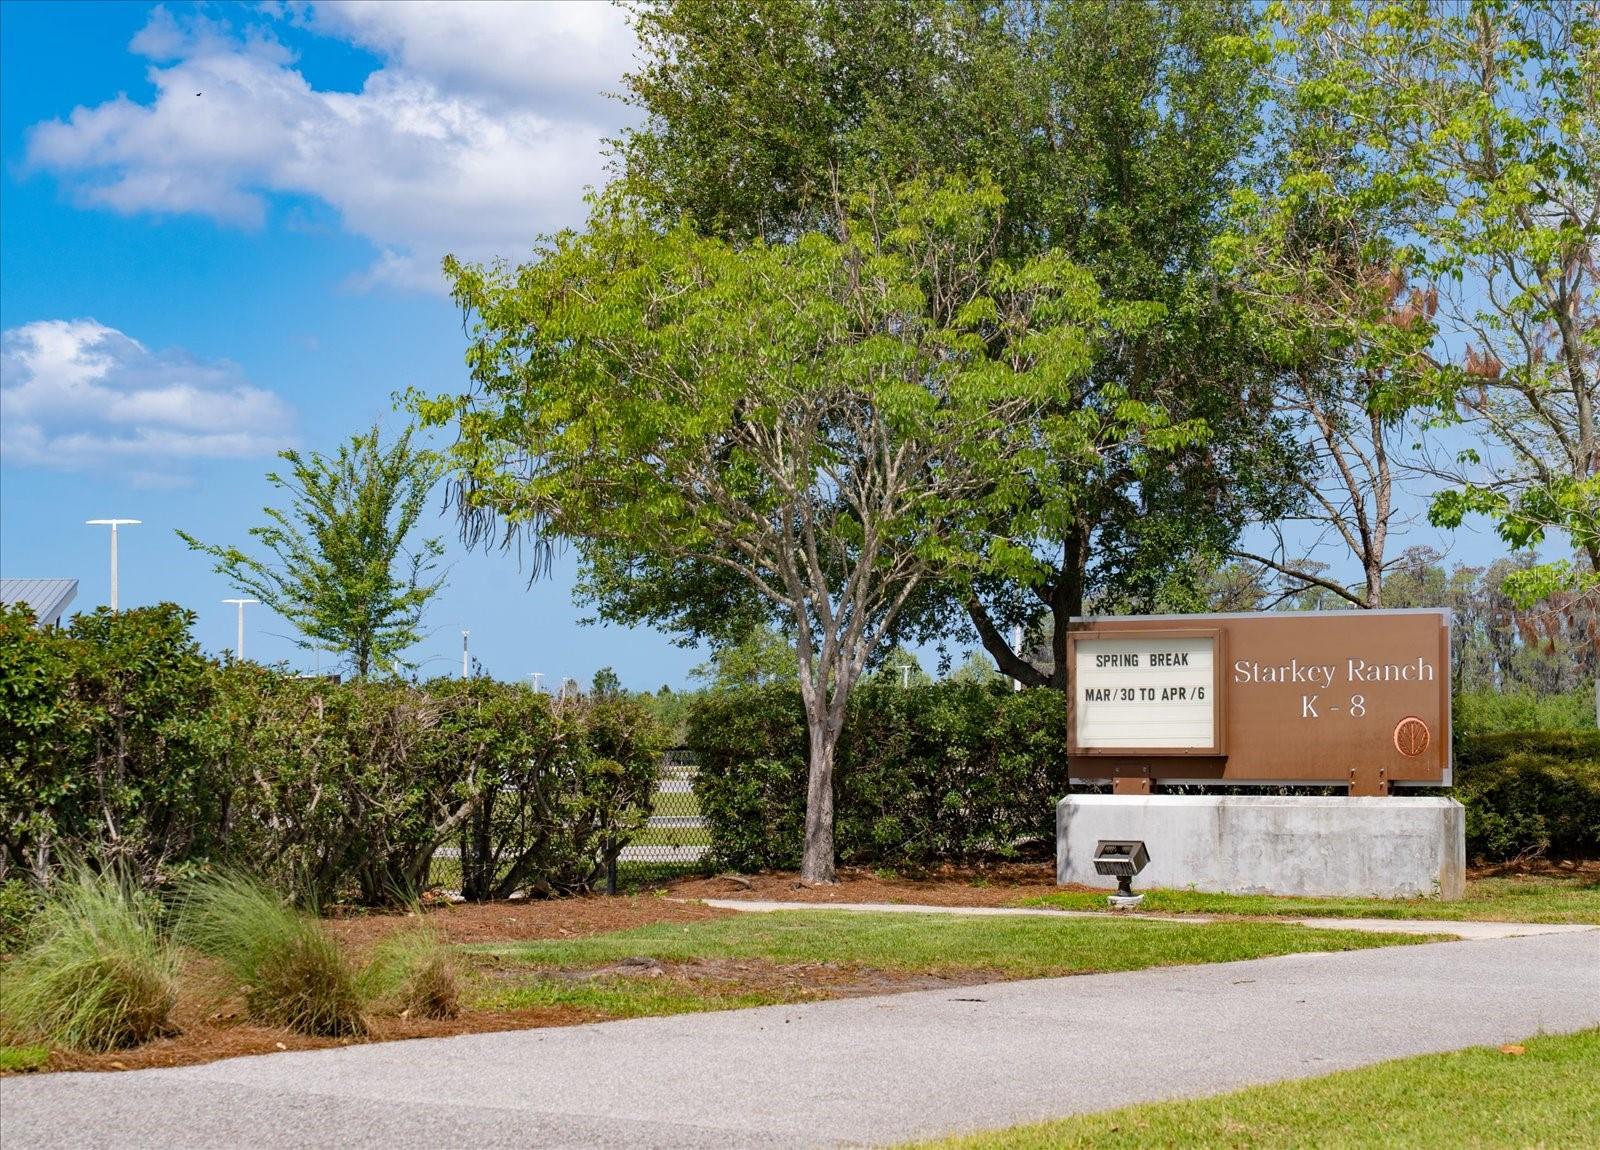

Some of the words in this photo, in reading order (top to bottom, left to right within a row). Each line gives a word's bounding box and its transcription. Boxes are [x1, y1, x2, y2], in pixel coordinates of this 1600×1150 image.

[1095, 653, 1139, 668] SPRING
[1149, 652, 1189, 667] BREAK
[1234, 659, 1336, 689] Starkey
[1347, 657, 1434, 682] Ranch
[1139, 687, 1155, 701] TO
